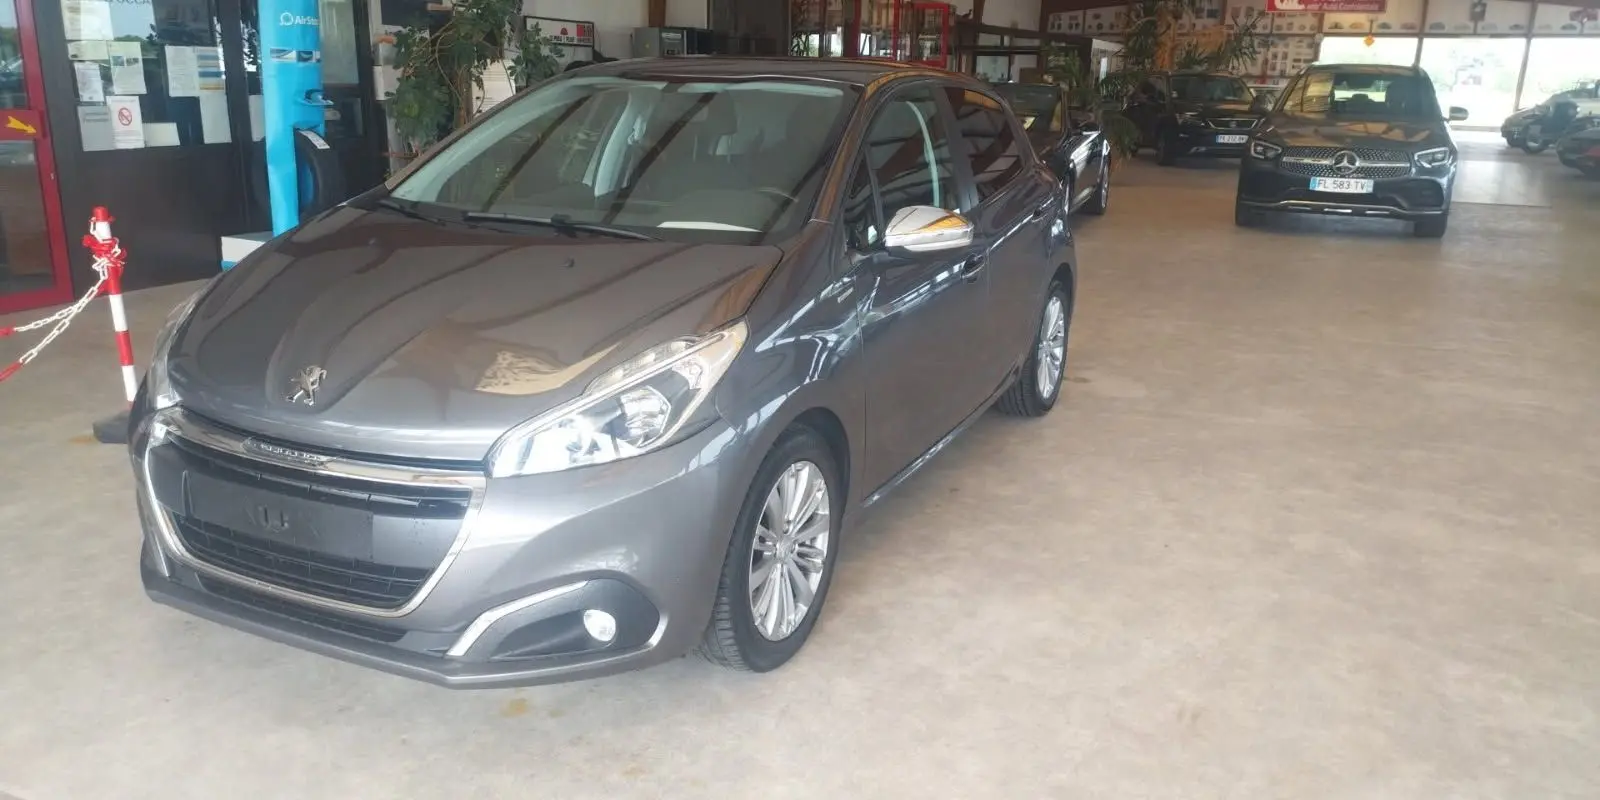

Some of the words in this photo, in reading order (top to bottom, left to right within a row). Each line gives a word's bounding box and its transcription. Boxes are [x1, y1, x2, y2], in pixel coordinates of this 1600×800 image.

[1318, 178, 1328, 189] FL
[1333, 179, 1350, 190] 583
[1354, 181, 1366, 190] TV
